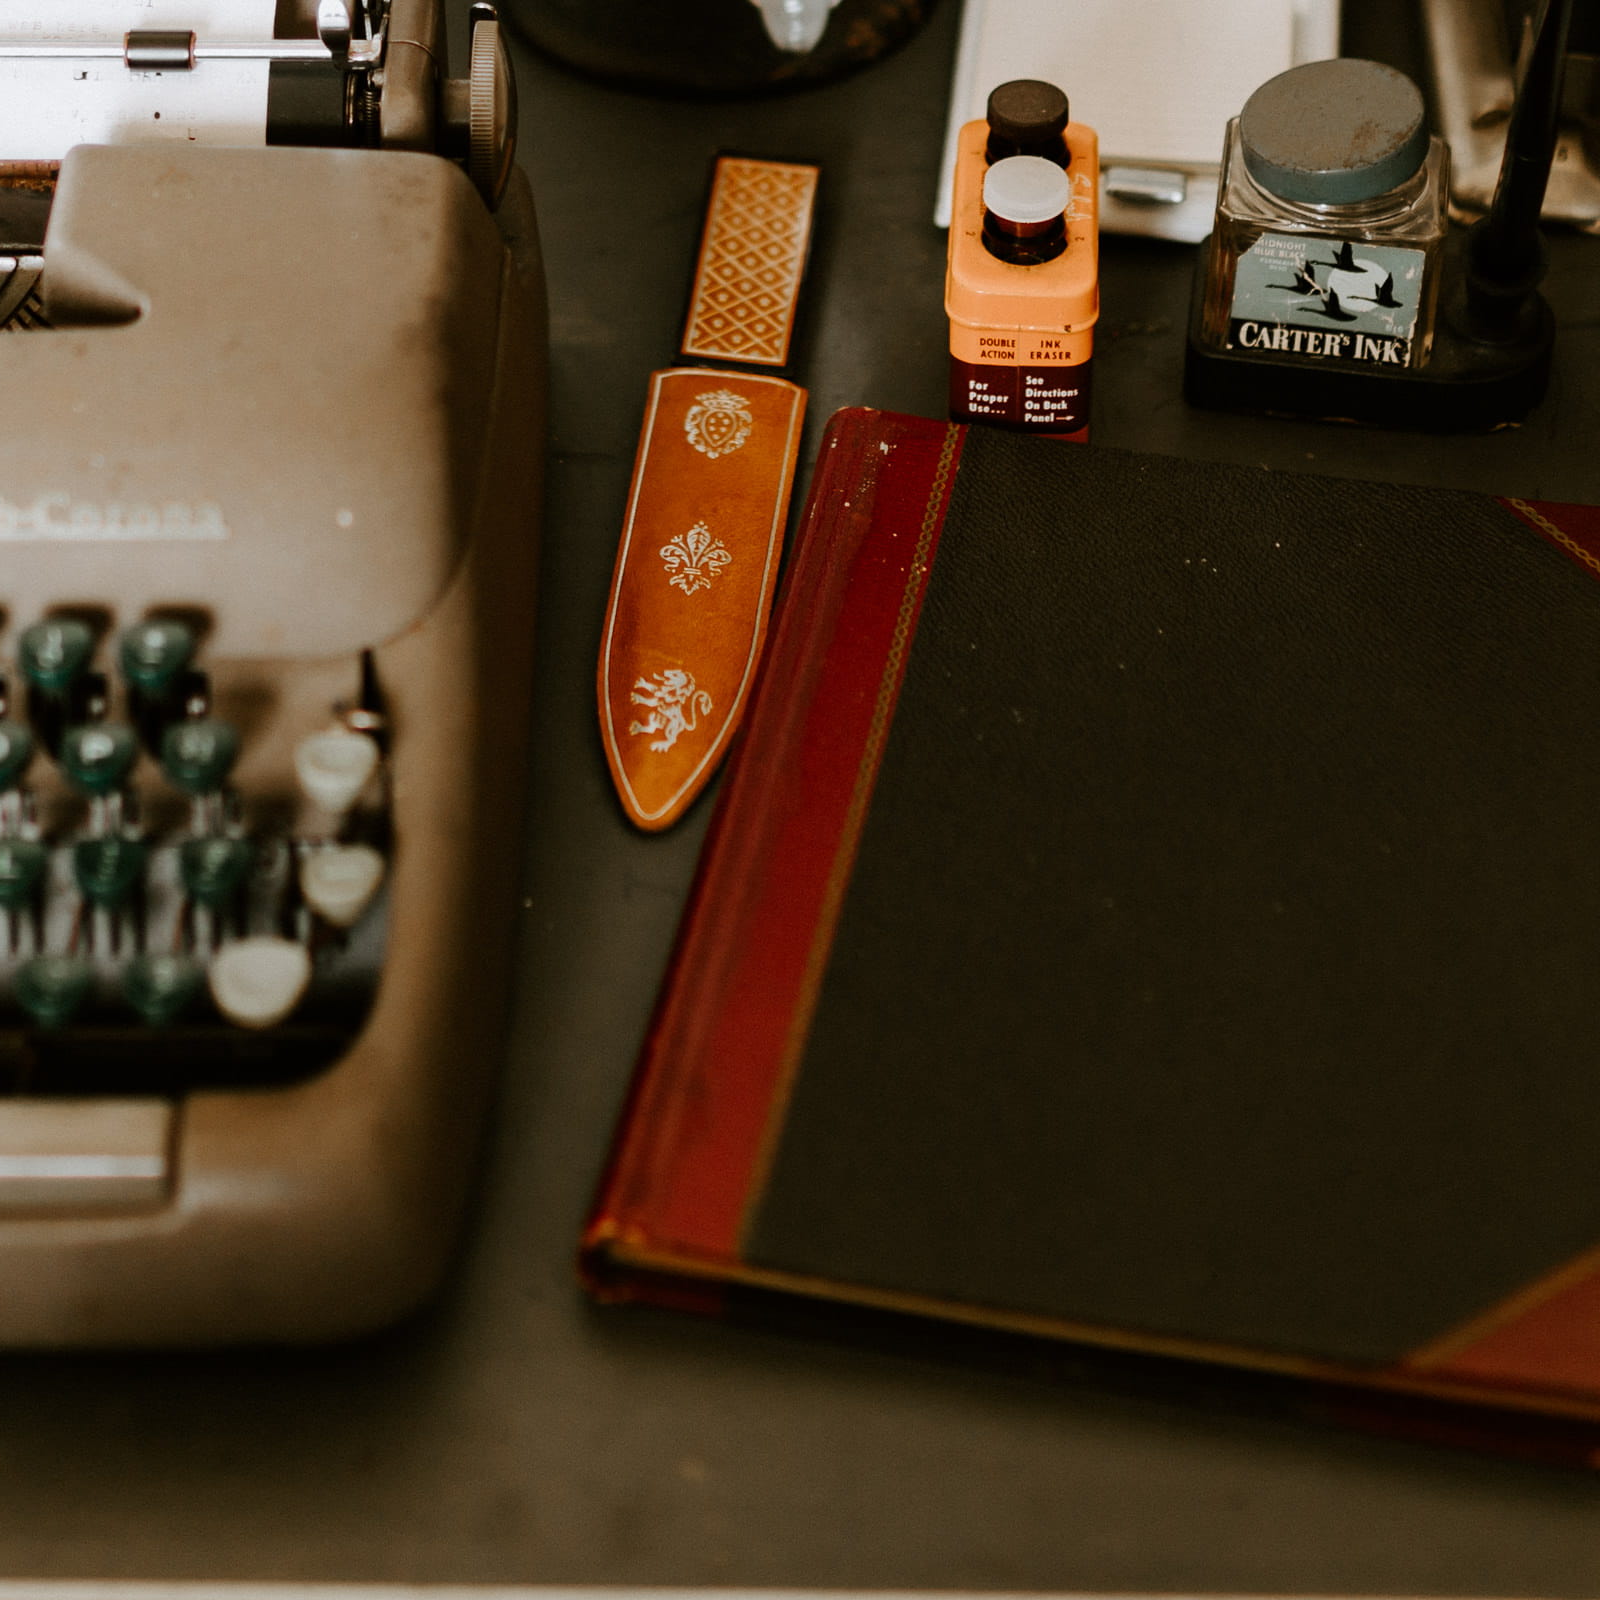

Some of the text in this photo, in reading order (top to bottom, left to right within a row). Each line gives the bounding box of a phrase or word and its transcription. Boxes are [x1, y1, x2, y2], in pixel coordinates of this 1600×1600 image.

[1254, 247, 1274, 257] BLUE
[980, 338, 1016, 348] DOUBLE
[1040, 340, 1061, 348] INK
[1238, 322, 1403, 364] CARTER's INK
[981, 350, 1015, 359] ACTION
[1030, 352, 1071, 360] ERASER
[969, 380, 988, 390] For
[1025, 375, 1044, 385] See
[969, 391, 1008, 404] Proper
[1025, 388, 1078, 398] Directions
[969, 402, 1006, 414] Use...
[1025, 400, 1068, 410] On Back
[1024, 412, 1055, 422] Panel
